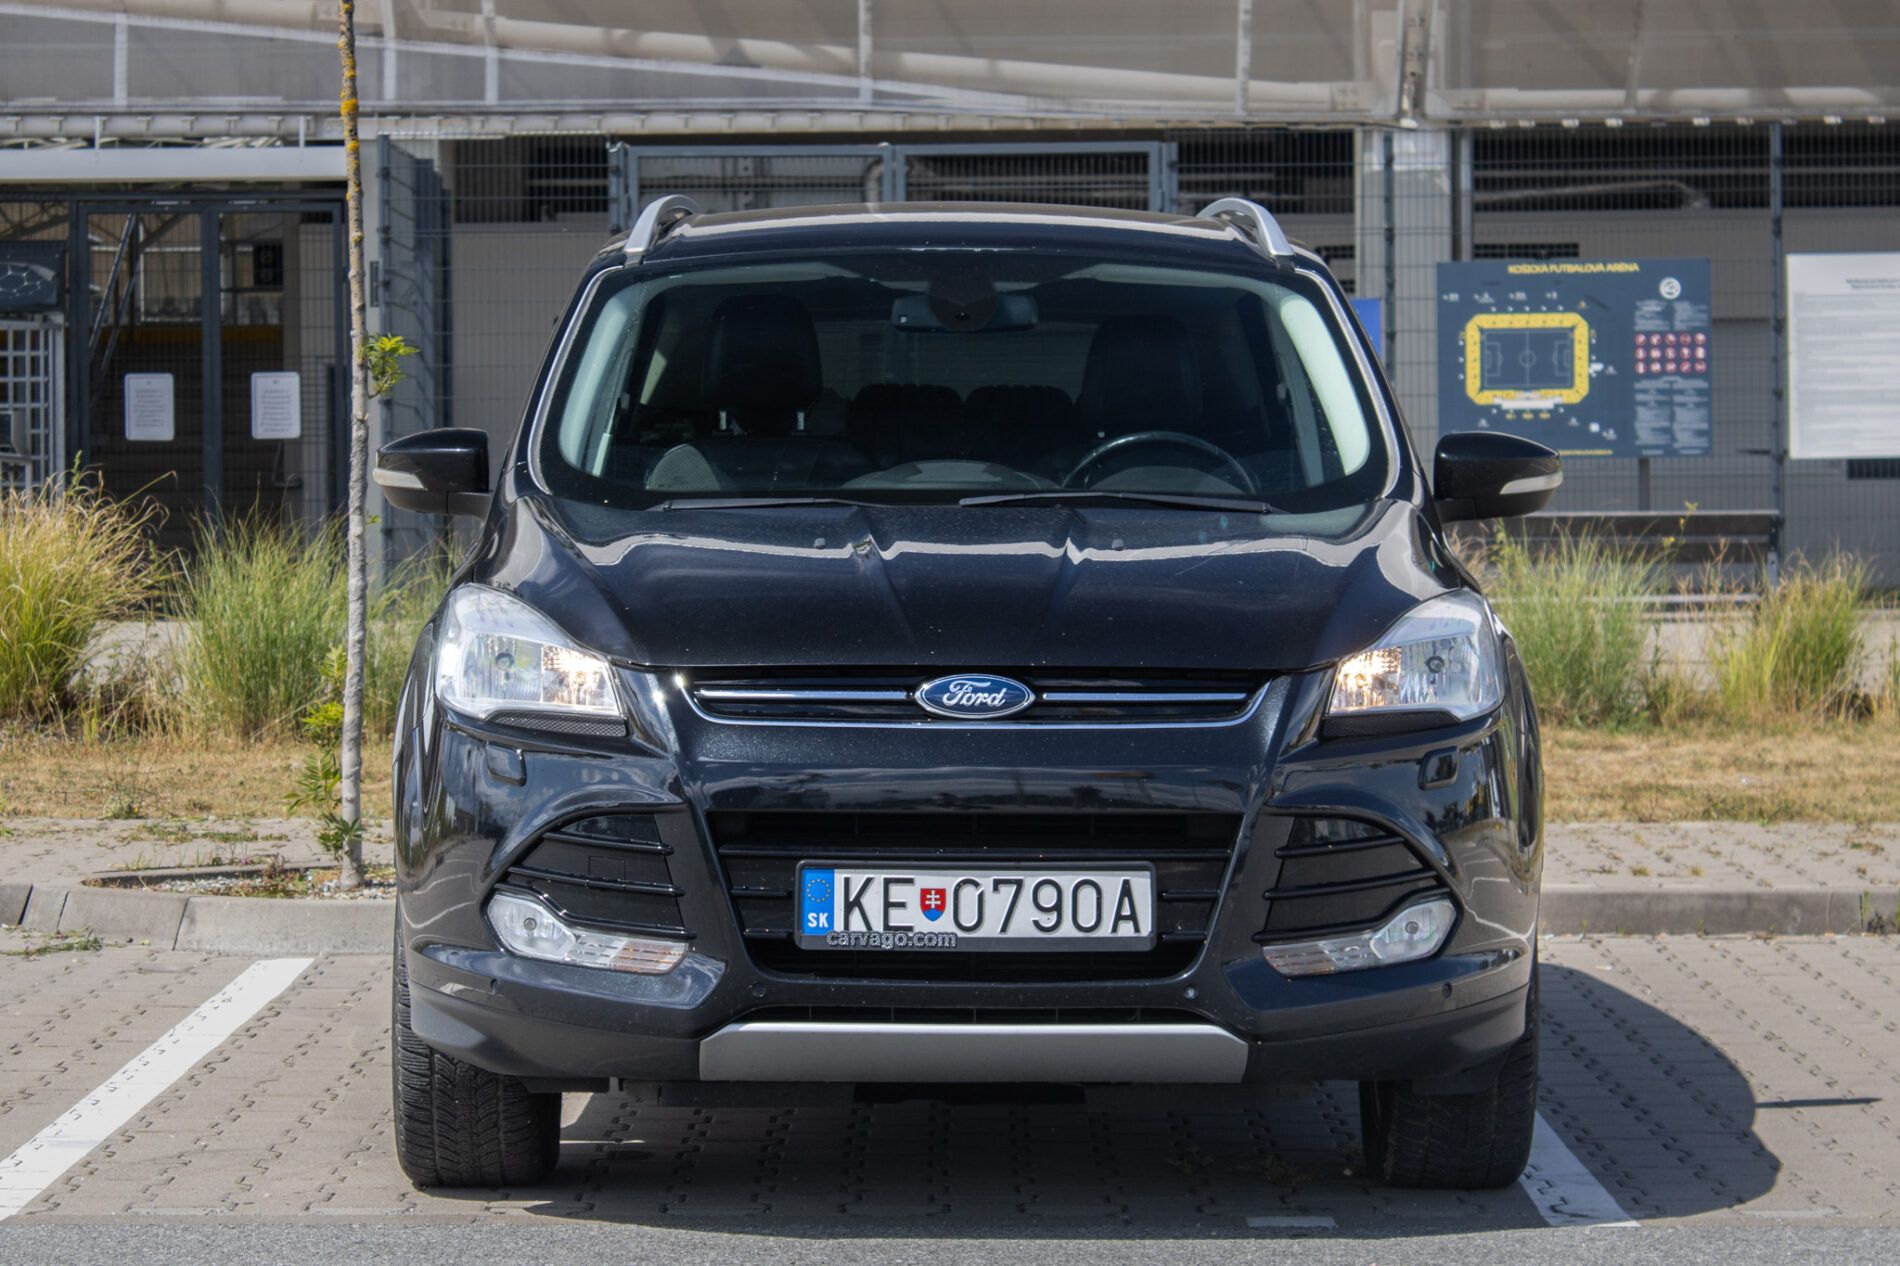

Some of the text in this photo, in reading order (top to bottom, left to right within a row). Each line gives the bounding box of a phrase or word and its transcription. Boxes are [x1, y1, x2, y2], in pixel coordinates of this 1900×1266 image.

[942, 680, 1007, 707] Ford
[843, 876, 914, 932] KE
[807, 912, 829, 928] SK
